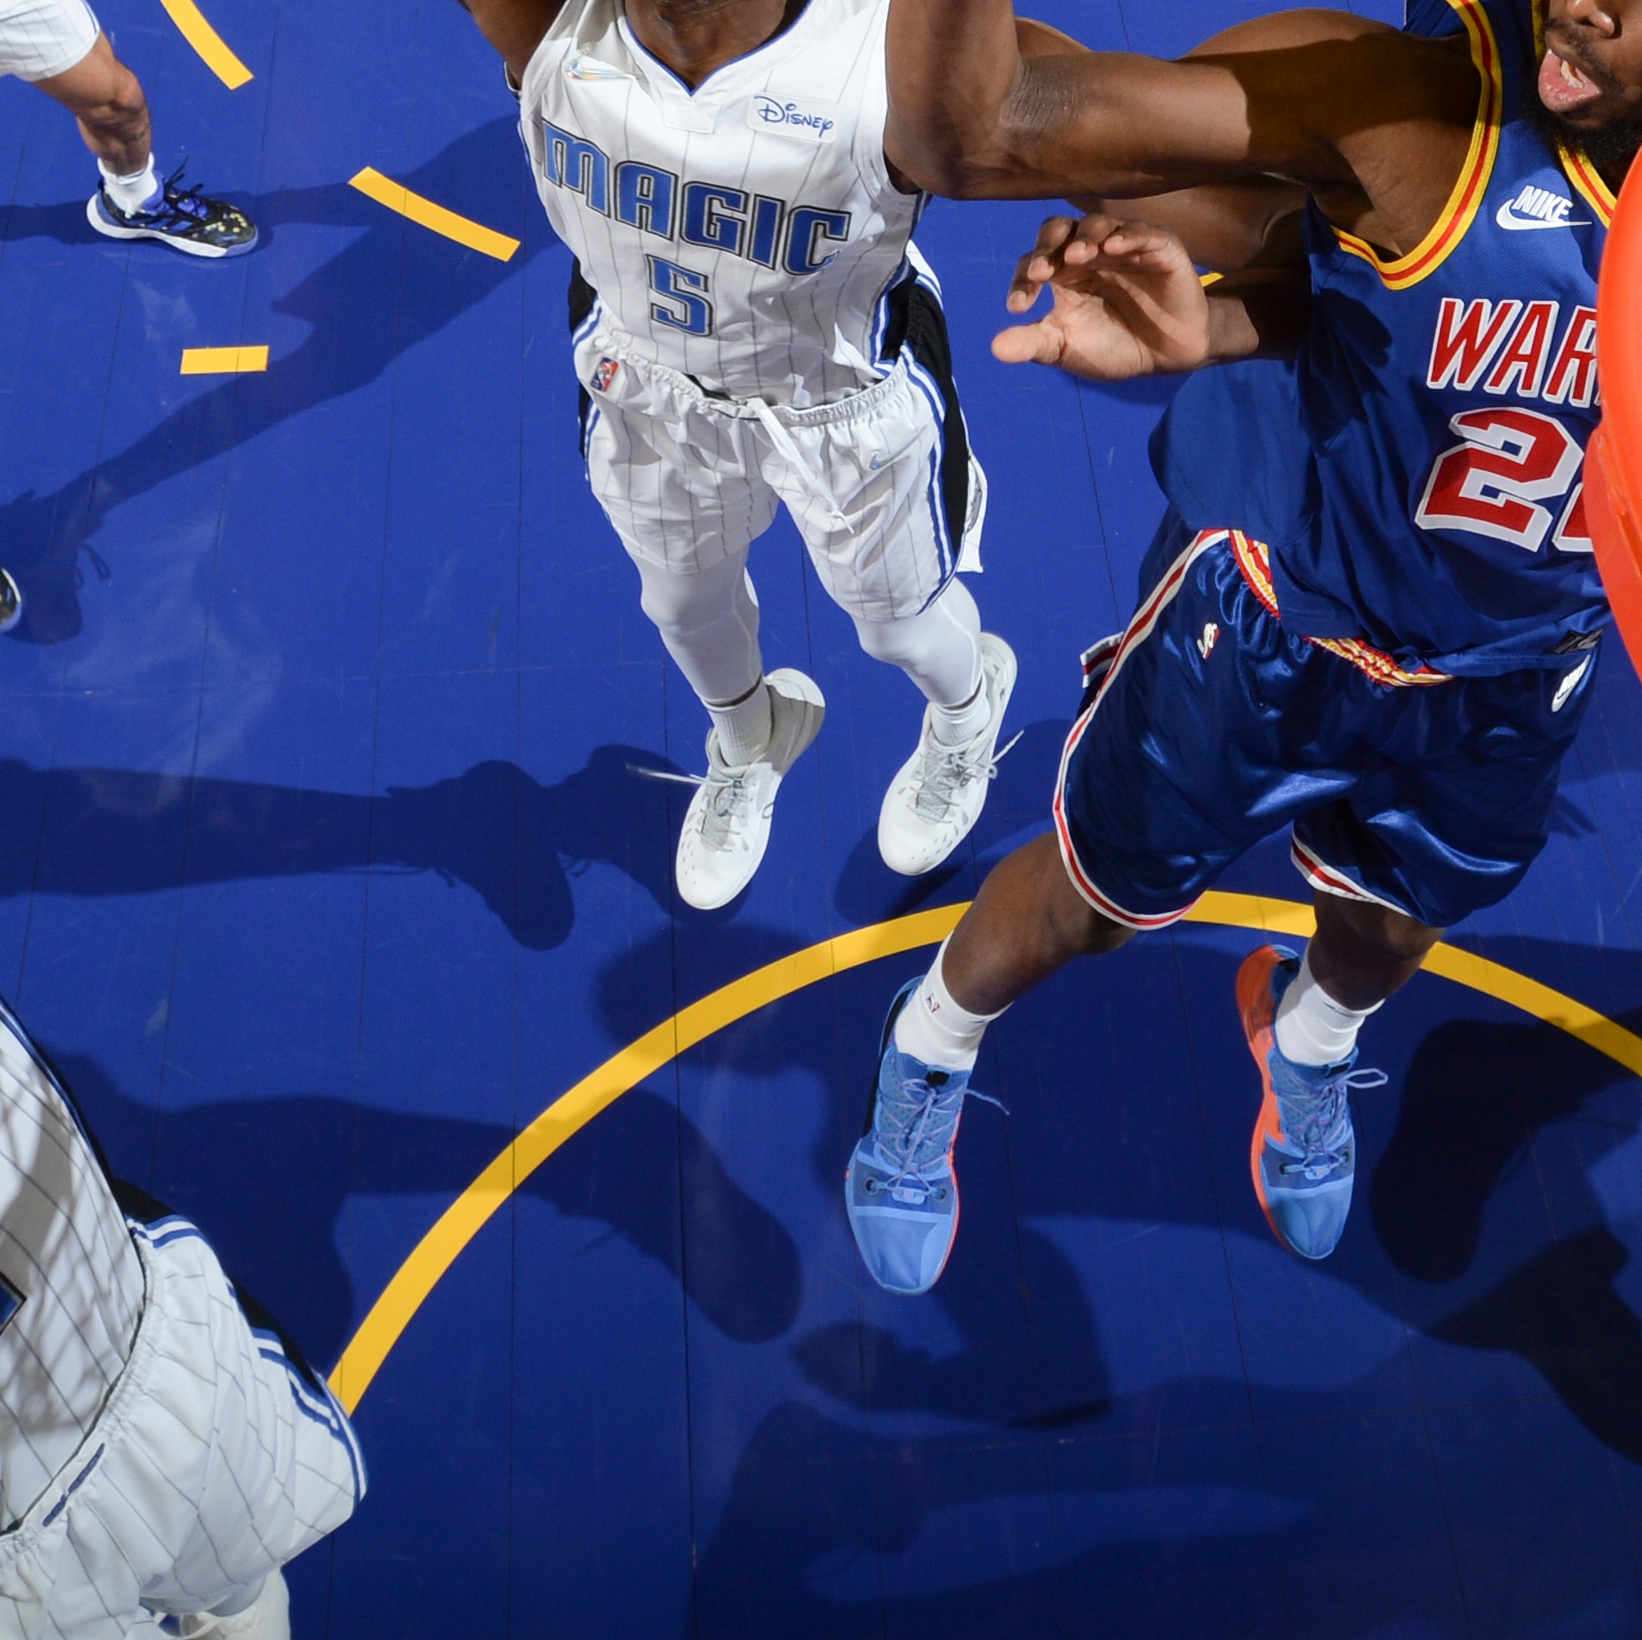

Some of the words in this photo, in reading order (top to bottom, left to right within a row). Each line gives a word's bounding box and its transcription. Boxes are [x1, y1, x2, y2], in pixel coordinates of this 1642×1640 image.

[541, 117, 852, 276] MAGIC
[1511, 185, 1574, 222] NIKE
[645, 253, 713, 337] 5
